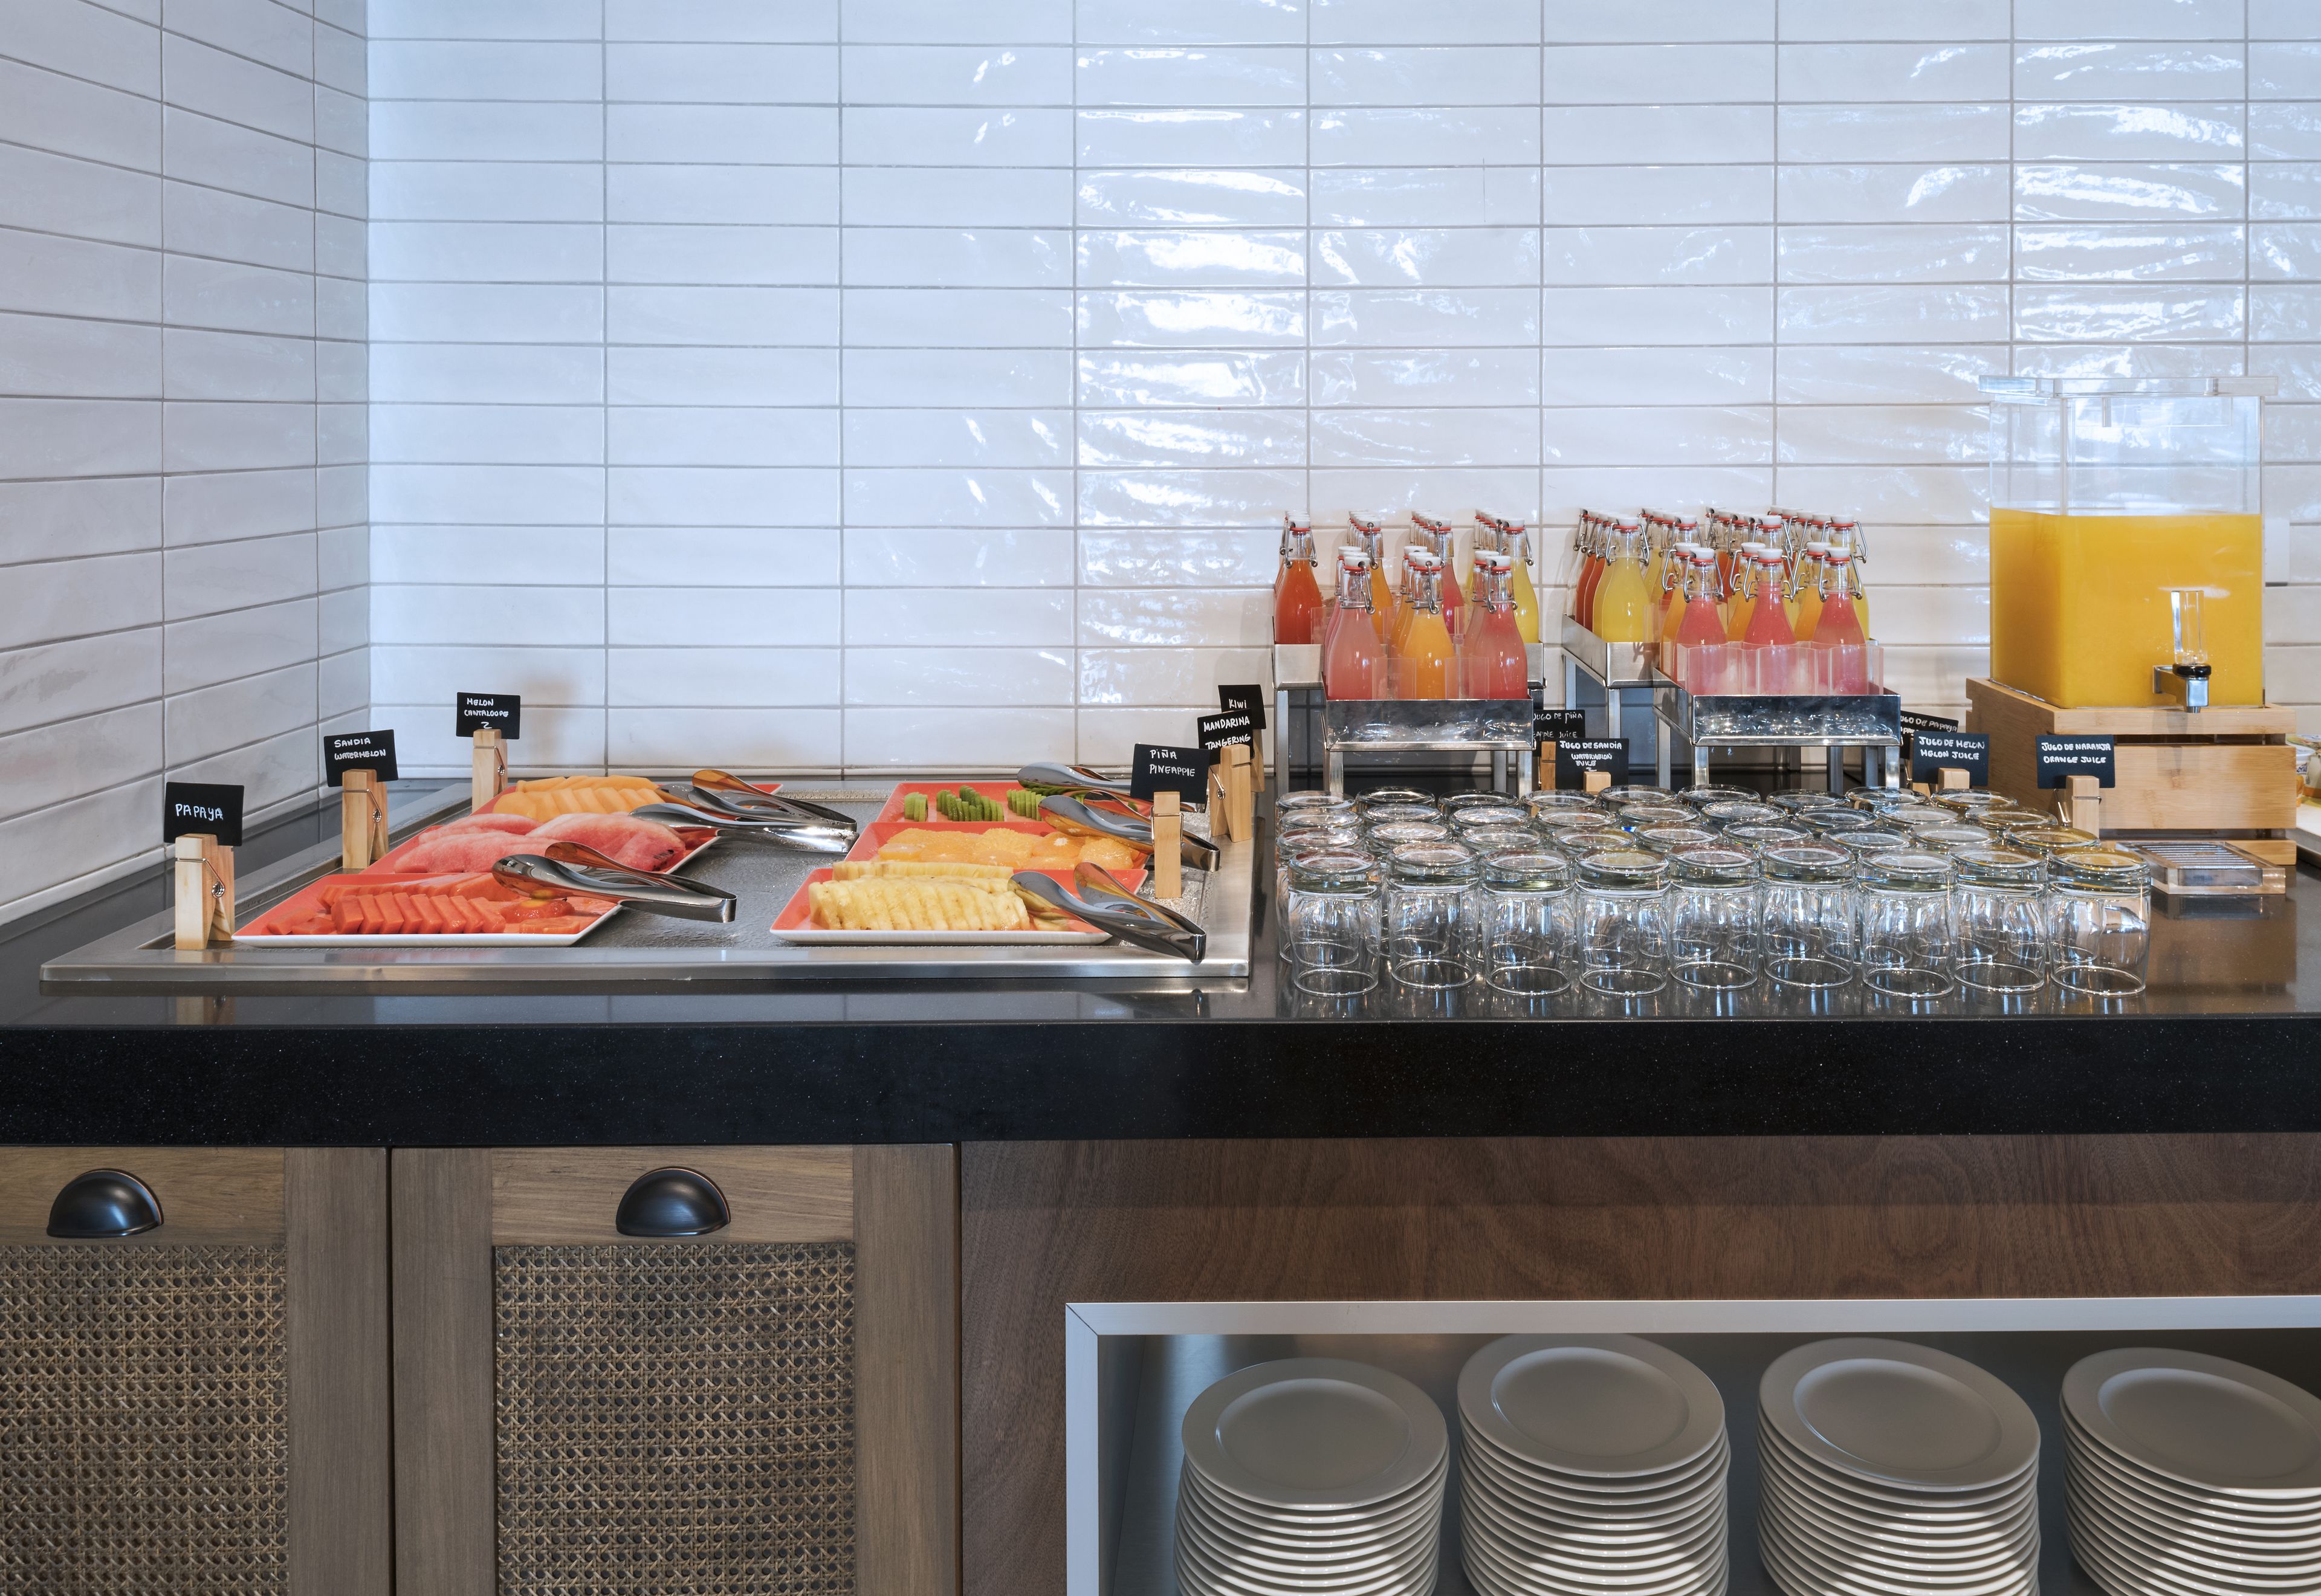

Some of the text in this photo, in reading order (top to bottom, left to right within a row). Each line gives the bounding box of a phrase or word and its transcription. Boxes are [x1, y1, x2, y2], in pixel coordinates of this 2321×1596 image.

[1203, 716, 1250, 732] MANDARINA
[1929, 722, 1957, 732] PAPAYA
[334, 738, 371, 748] SANDIA
[1559, 741, 1581, 749] JUGO
[1918, 736, 1943, 746] JUGO
[1956, 740, 1984, 749] MELON
[2041, 742, 2063, 751] JUGO
[335, 749, 386, 760] WATERMELON
[1920, 749, 1979, 760] MELON JUICE
[175, 804, 223, 821] PAPAYA
